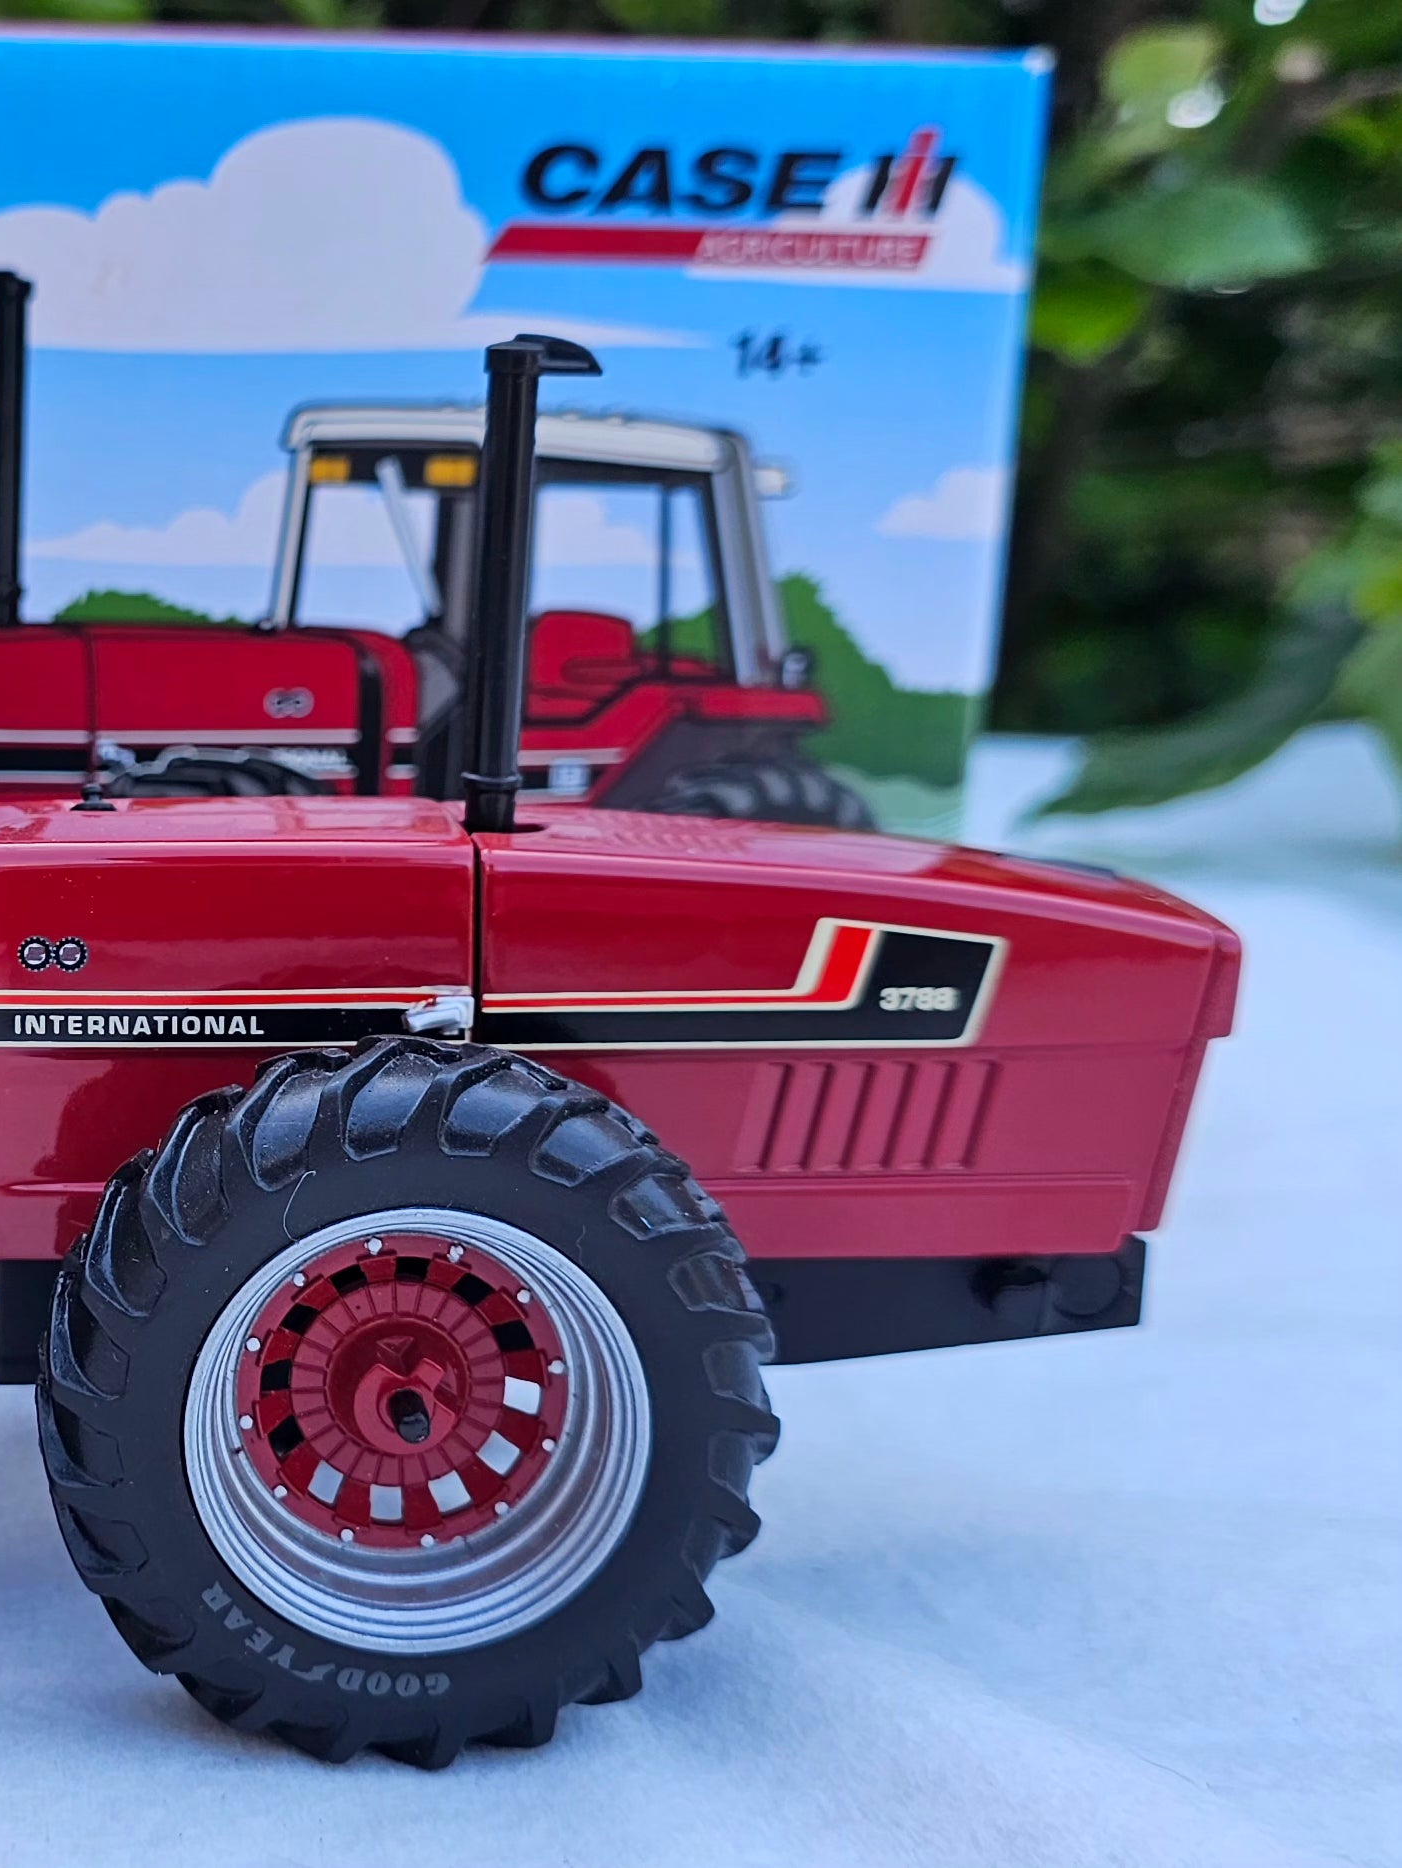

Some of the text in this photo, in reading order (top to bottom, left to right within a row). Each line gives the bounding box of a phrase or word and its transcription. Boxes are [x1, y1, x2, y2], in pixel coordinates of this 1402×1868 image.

[521, 145, 840, 215] CASE
[879, 986, 961, 1012] 3788
[13, 1013, 265, 1037] INTERNATIONAL
[200, 1580, 452, 1698] GOODYEAR
